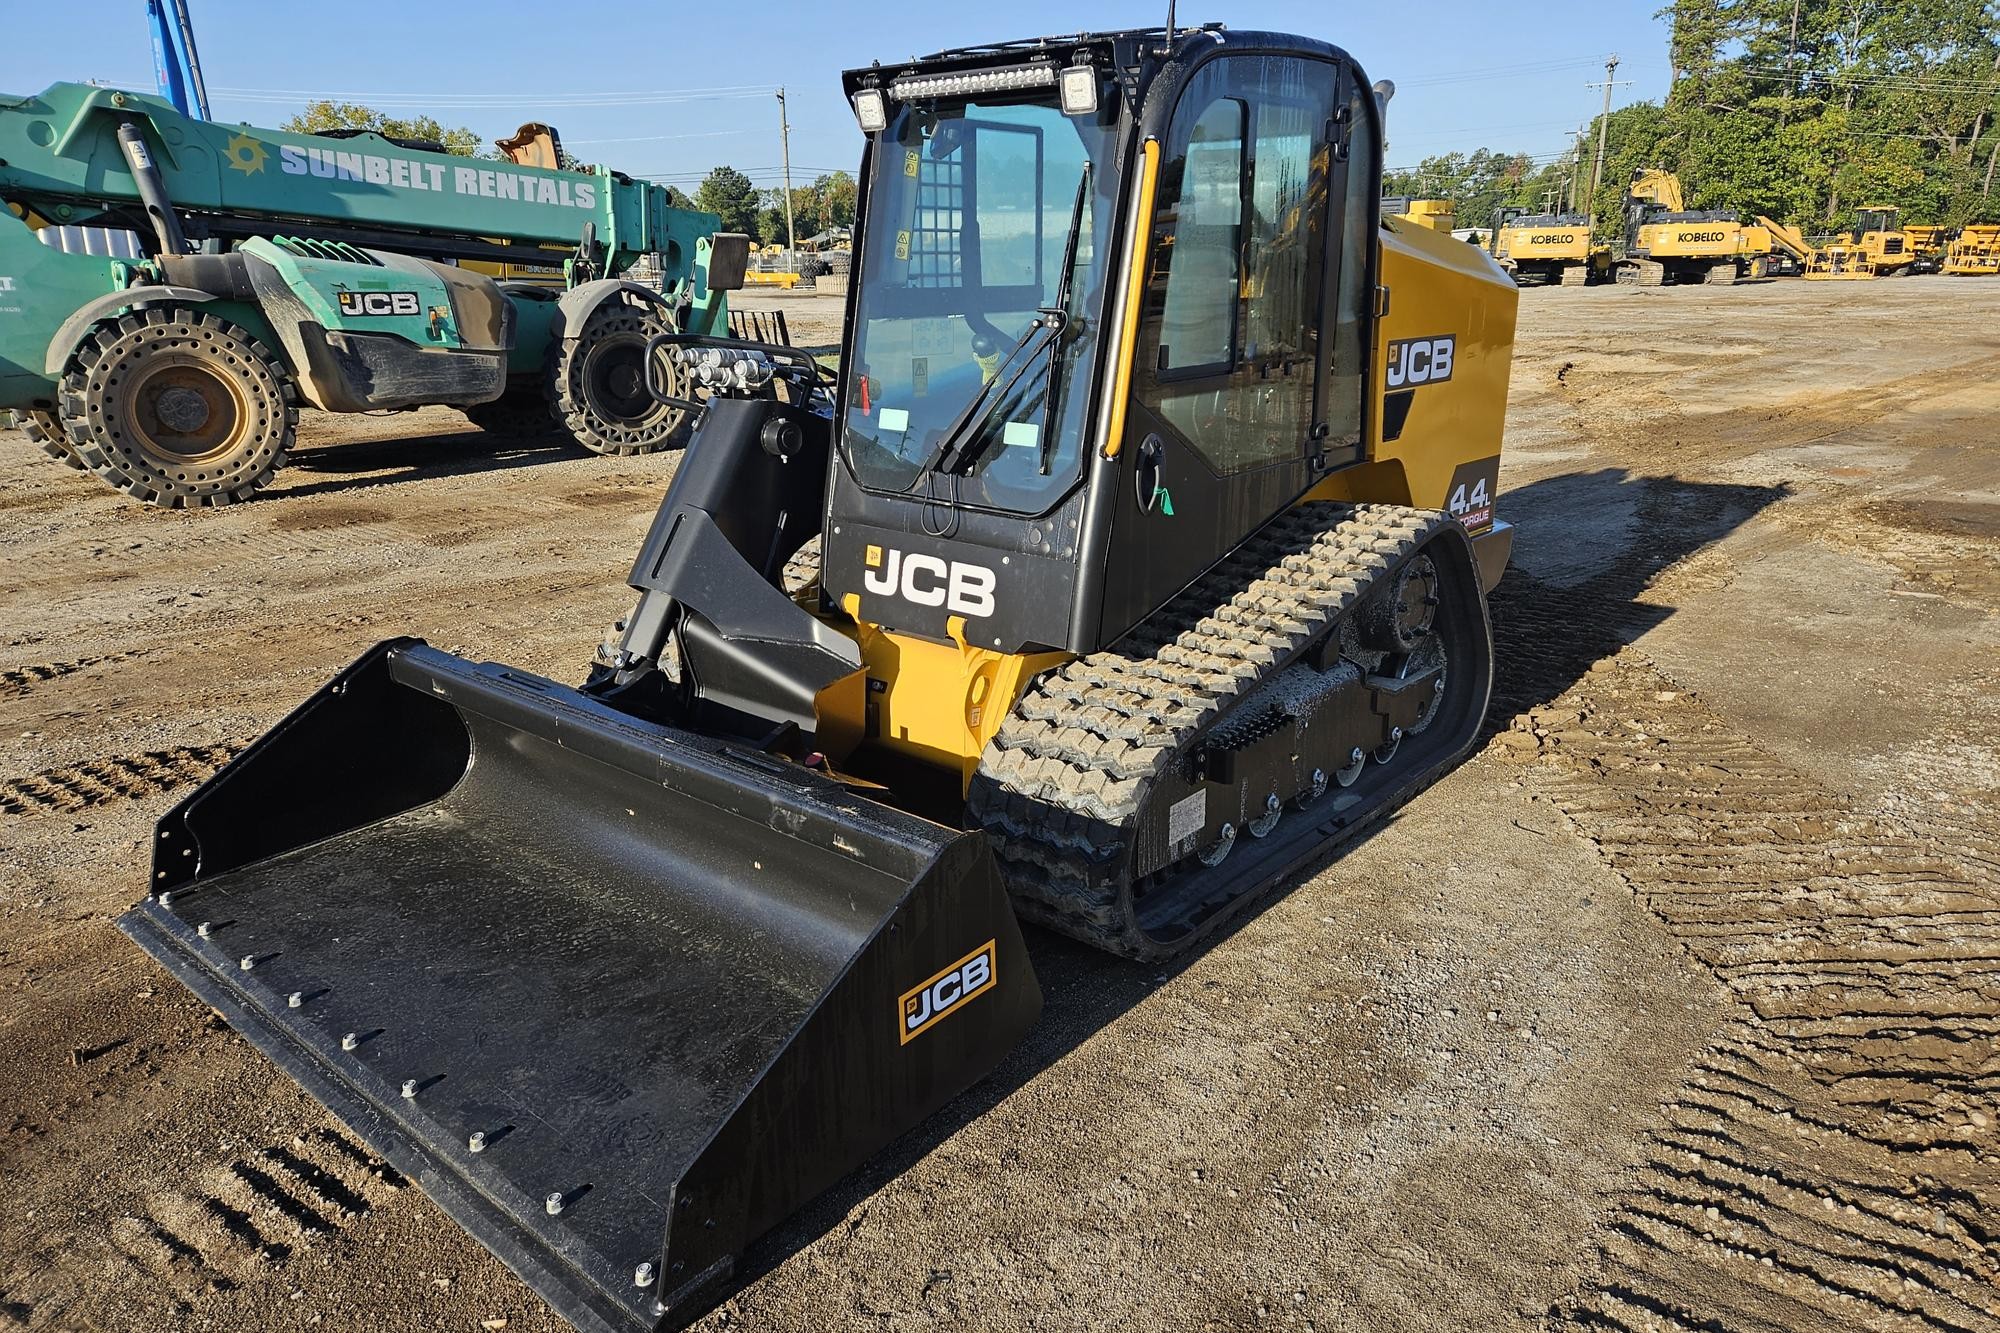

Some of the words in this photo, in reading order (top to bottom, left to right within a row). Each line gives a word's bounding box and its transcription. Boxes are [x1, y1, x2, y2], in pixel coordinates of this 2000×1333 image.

[281, 144, 446, 191] SUNBELT
[454, 166, 596, 209] RENTALS
[1531, 234, 1574, 244] KOBELCO
[1678, 232, 1725, 243] KOBELCO
[341, 293, 419, 315] JCB
[1387, 339, 1453, 386] JCB
[865, 549, 996, 617] JCB
[907, 954, 990, 1029] JCB
